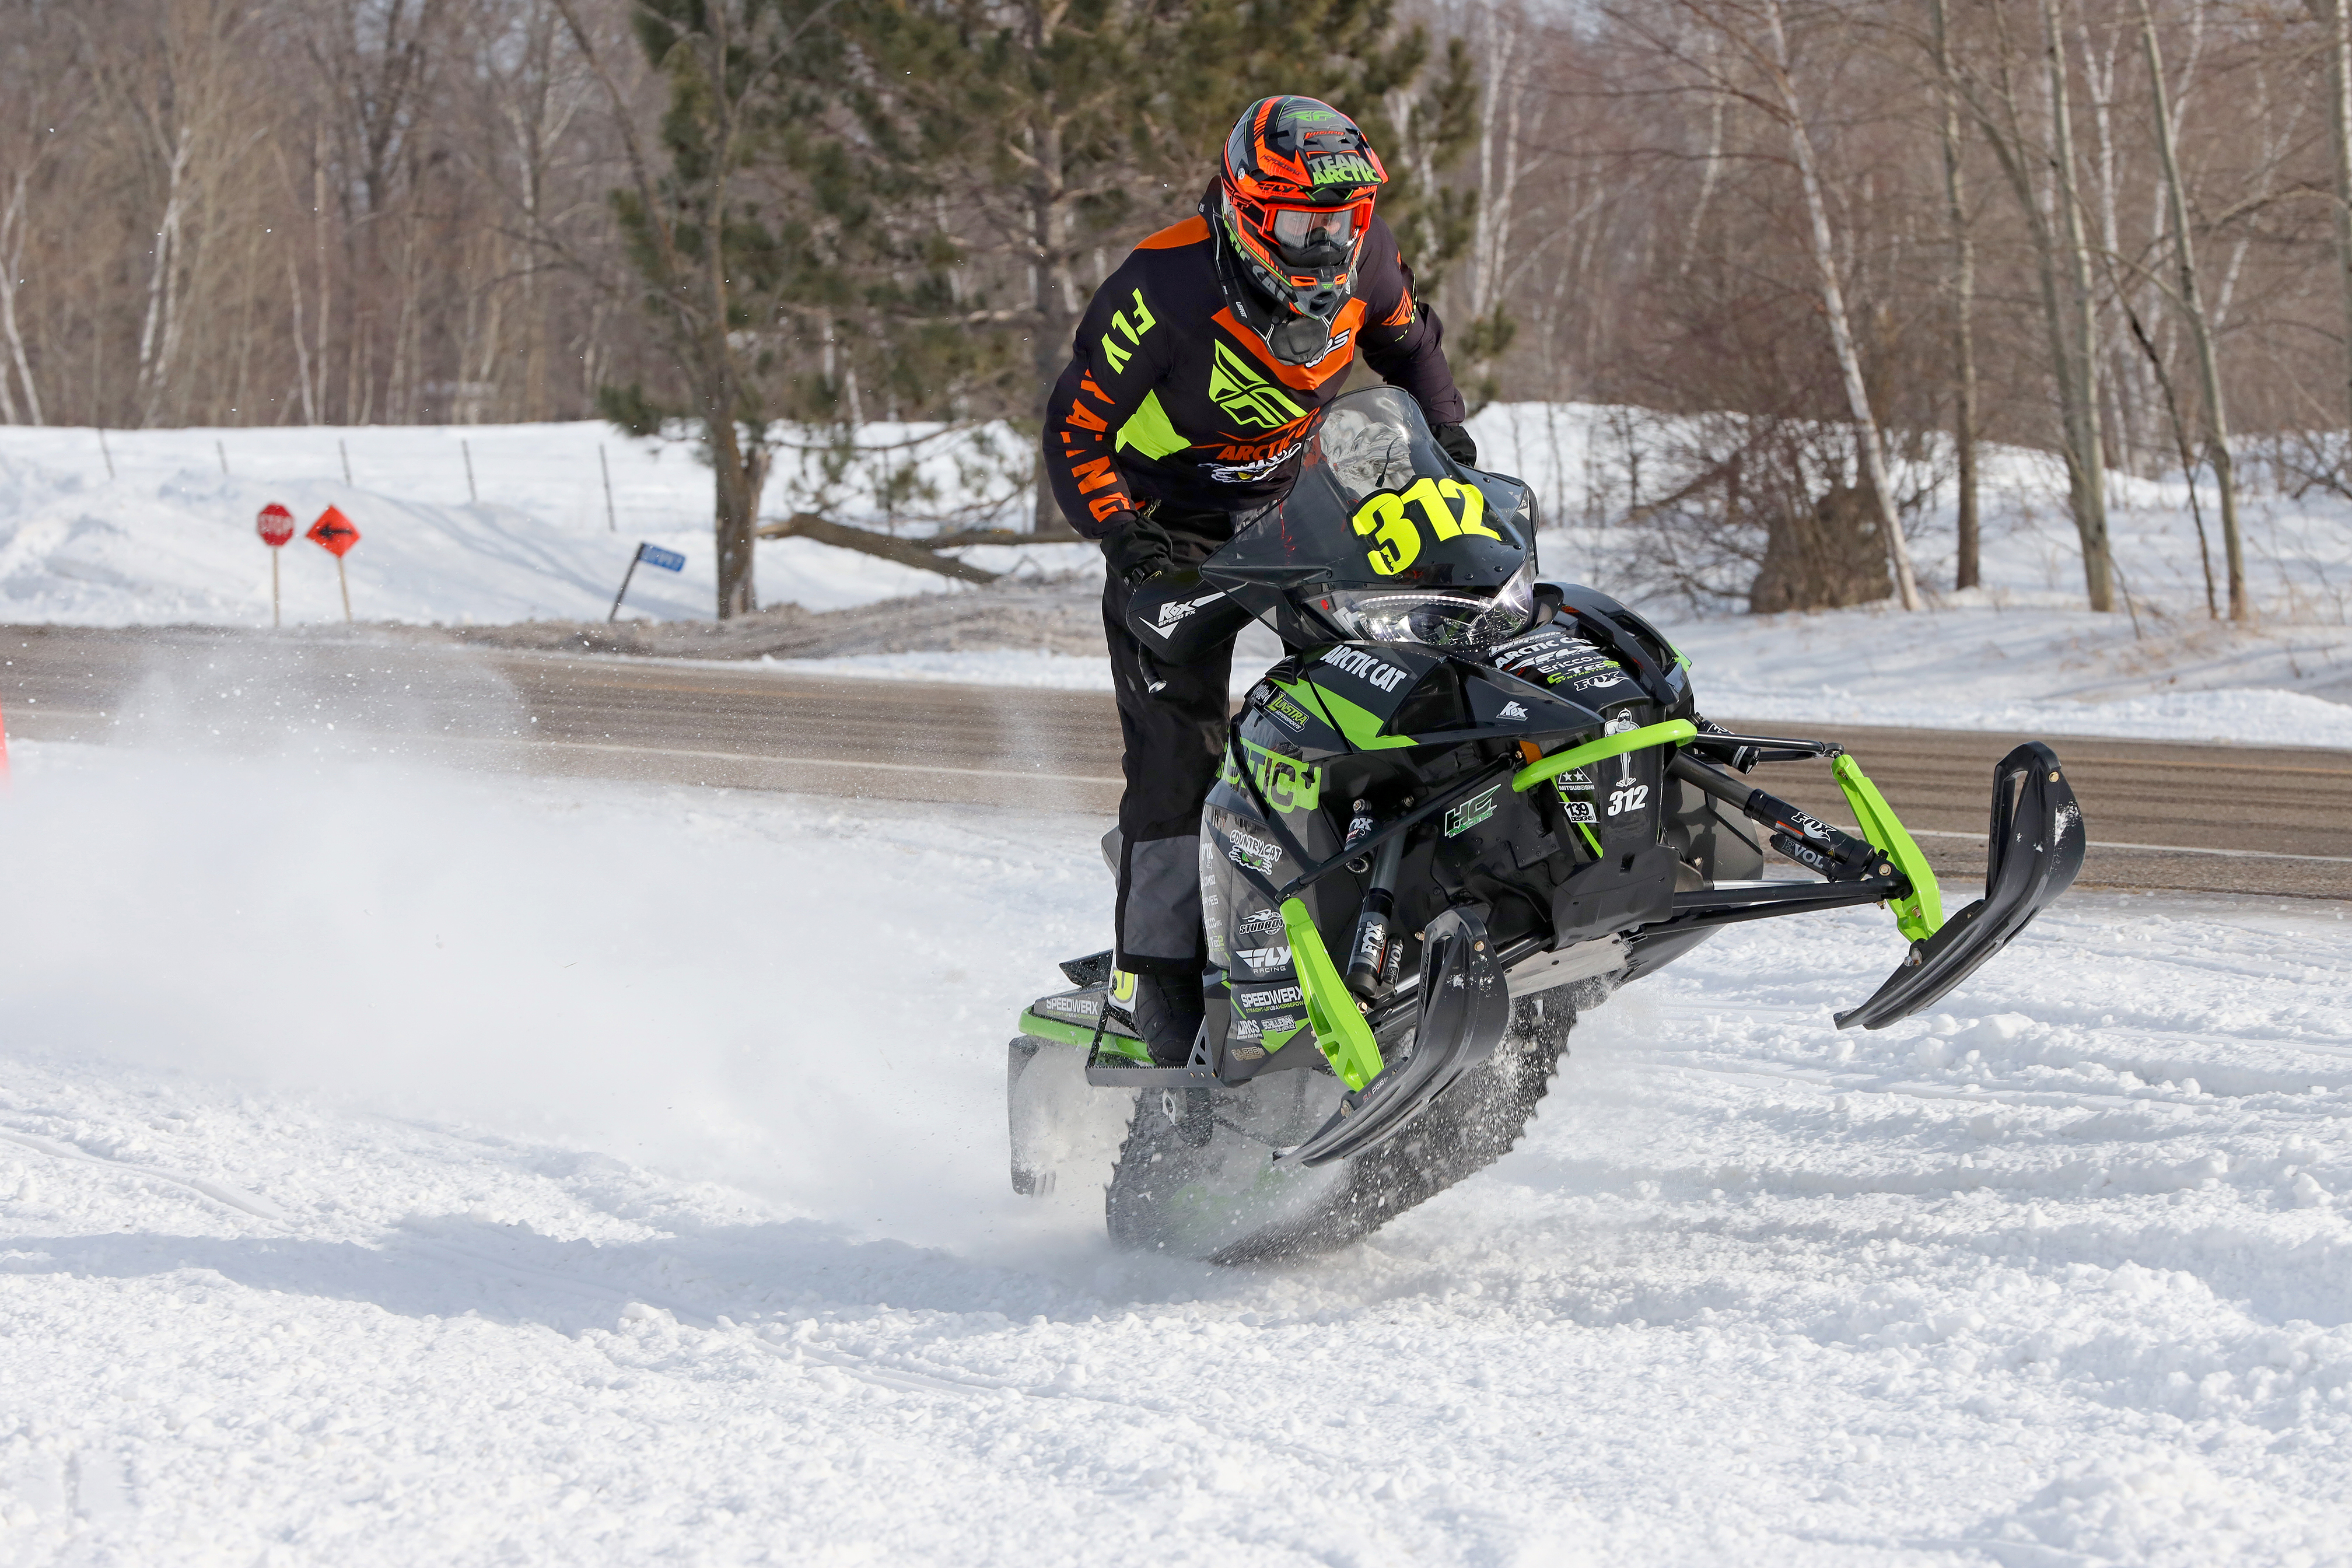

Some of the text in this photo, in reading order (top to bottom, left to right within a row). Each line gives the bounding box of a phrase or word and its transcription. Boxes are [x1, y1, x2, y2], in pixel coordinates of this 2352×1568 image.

[1307, 154, 1373, 176] TEAM
[1312, 166, 1382, 186] ARCTIC
[1258, 183, 1297, 194] FLY
[1101, 287, 1157, 374] FLY
[1352, 477, 1503, 576] 312
[1158, 608, 1197, 627] SPEED FX
[1494, 639, 1560, 670] ARCTIC
[1319, 643, 1408, 694] ARCTIC CAT
[1573, 670, 1623, 692] FOX
[1566, 802, 1590, 816] 139
[1607, 785, 1649, 817] 312
[1349, 817, 1374, 832] OX
[1790, 811, 1838, 835] FOX
[1230, 830, 1265, 856] COUNTRY
[1781, 837, 1824, 869] EVOL
[1360, 921, 1384, 957] FOX
[1236, 946, 1292, 968] FLY
[1388, 943, 1404, 977] EVOL
[1253, 965, 1286, 974] RACING
[1046, 996, 1098, 1015] SPEEDWERX
[1240, 985, 1304, 1008] SPEEDWERX
[1279, 1000, 1304, 1010] HORSEPOW
